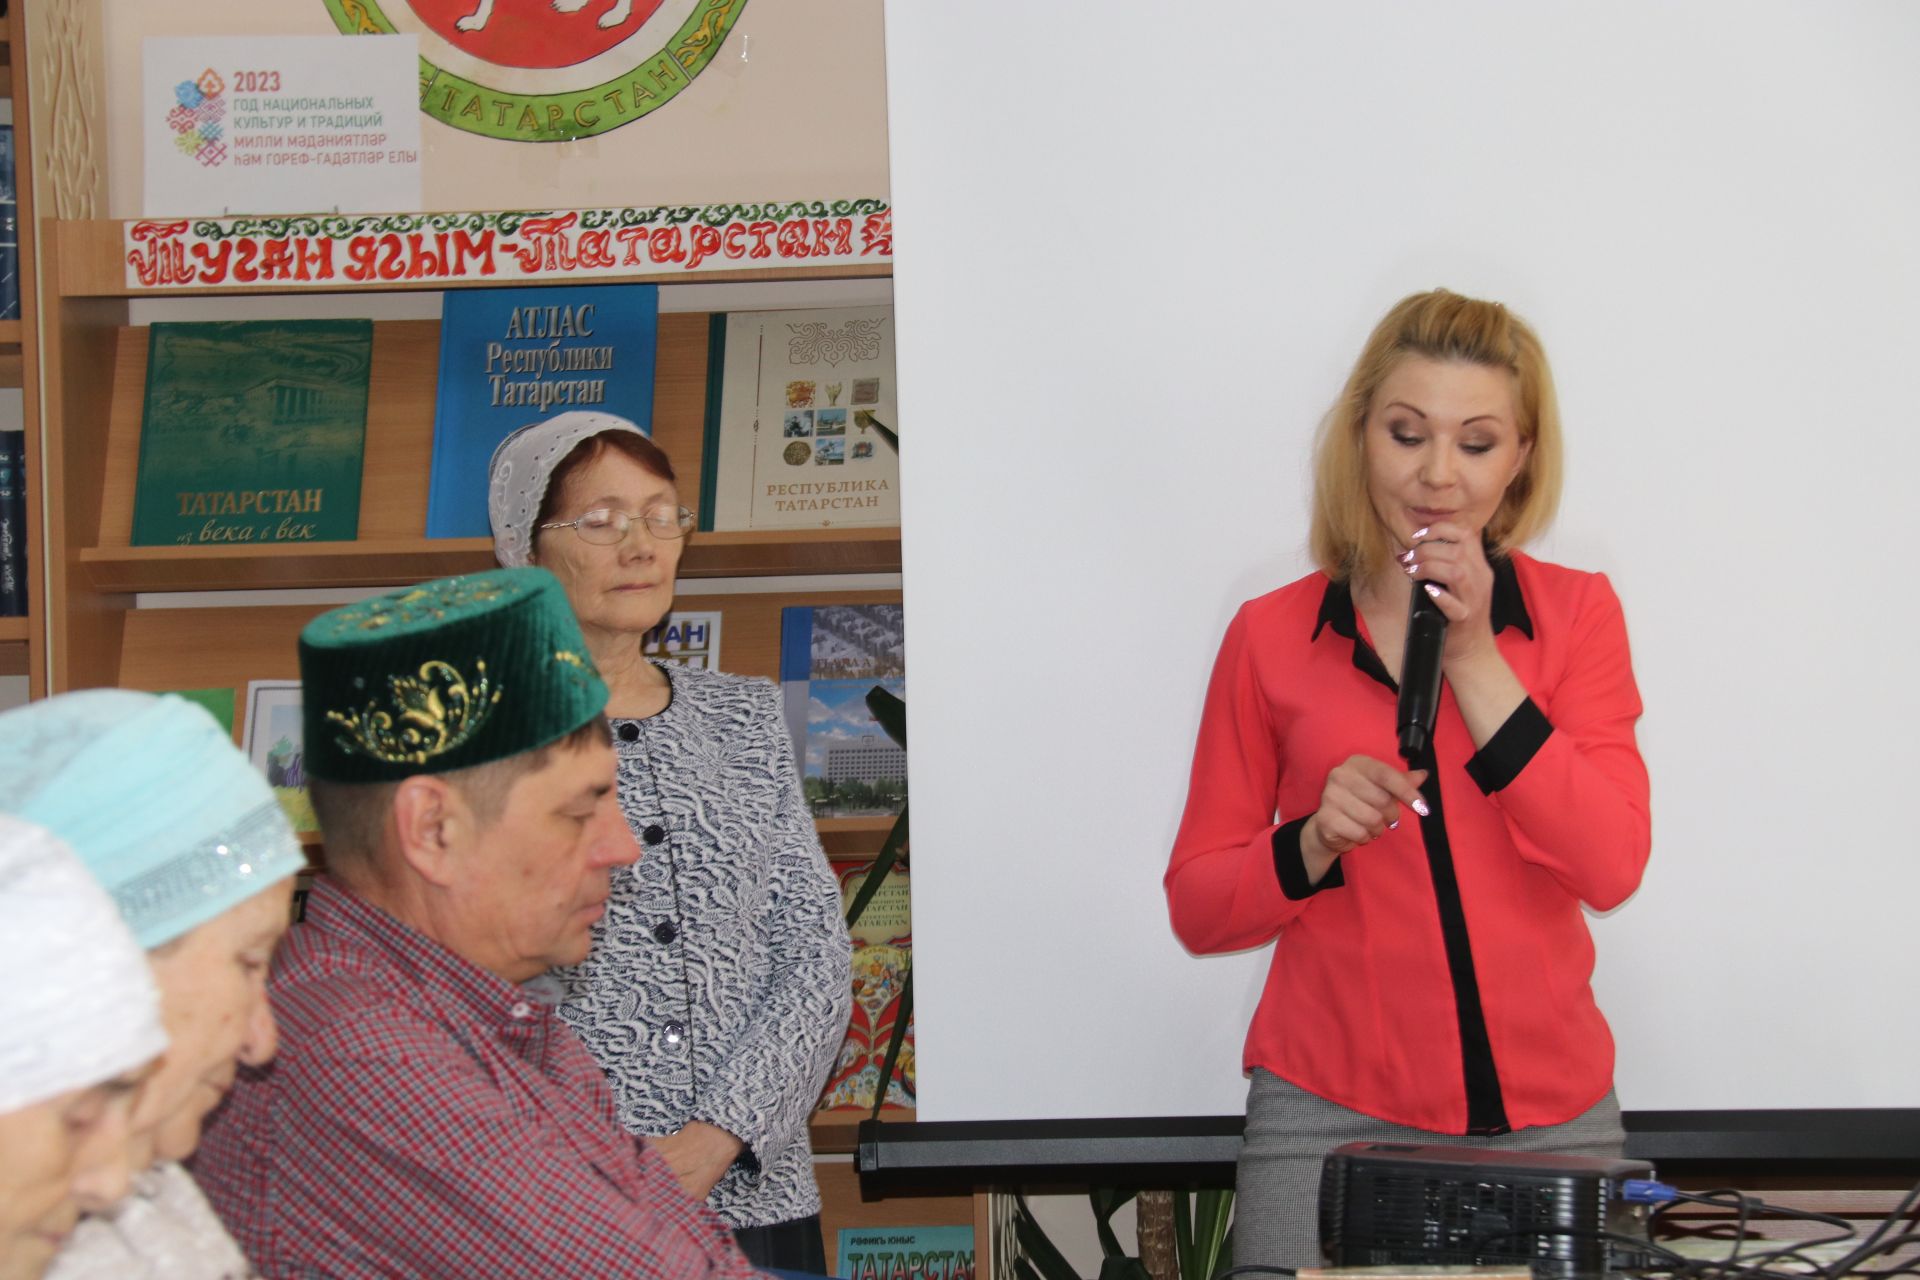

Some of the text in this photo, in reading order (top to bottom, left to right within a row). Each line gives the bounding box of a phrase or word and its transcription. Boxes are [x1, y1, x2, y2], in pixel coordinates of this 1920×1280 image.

[233, 71, 281, 93] 2023
[233, 97, 374, 114] ГОД НАЦИОНАЛЬНЫХ
[441, 60, 678, 132] ТАТАРСТАН
[233, 112, 383, 130] КУЛЬТУР И ТРАДИЦИЙ
[233, 135, 283, 149] МИЛЛИ
[388, 149, 418, 164] ЕЛЫ
[505, 303, 596, 340] АТЛАС
[484, 339, 614, 379] Республики
[489, 374, 606, 413] Татарстан
[766, 479, 889, 497] РЕСПУБЛИКА
[176, 488, 323, 516] ТАТАРСТАН
[775, 495, 880, 513] ТАТАРСТАН
[199, 518, 254, 541] века
[275, 517, 317, 540] век
[652, 624, 704, 643] ТАН
[888, 1235, 916, 1245] ЮНЫС
